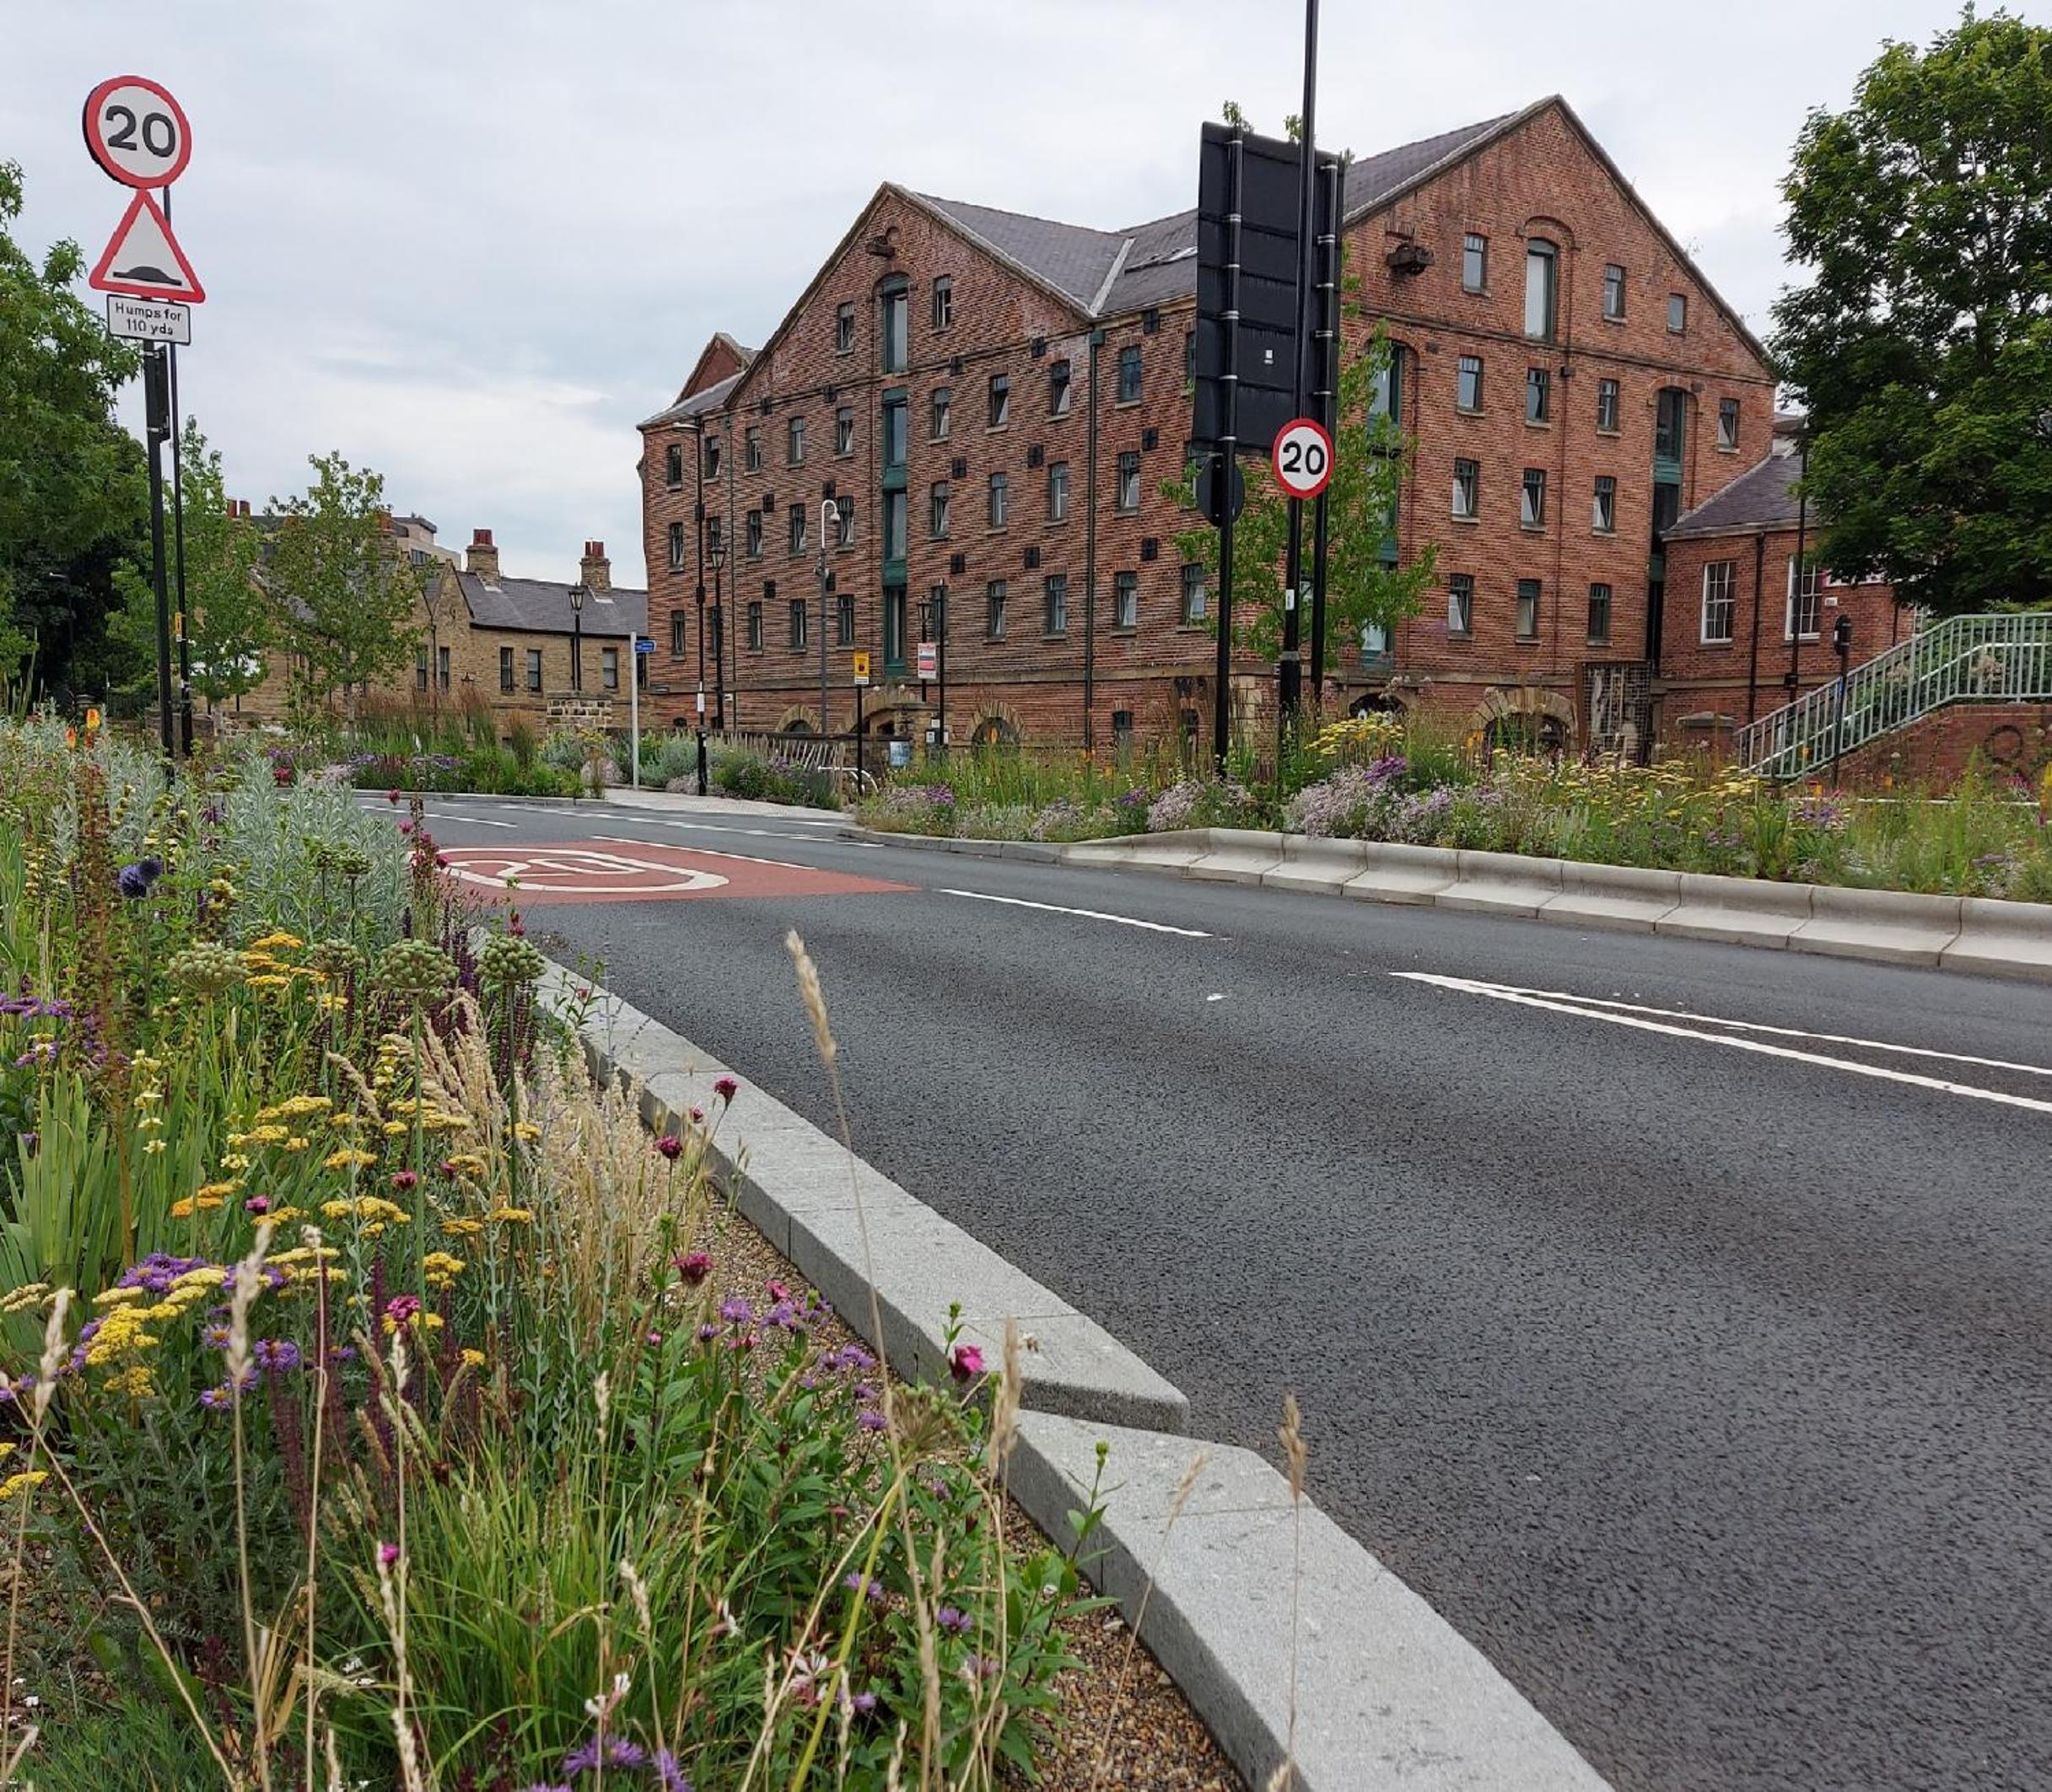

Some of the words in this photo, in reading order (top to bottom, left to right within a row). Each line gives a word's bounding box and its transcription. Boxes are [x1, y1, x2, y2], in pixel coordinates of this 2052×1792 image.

[105, 105, 176, 158] 20
[115, 303, 161, 319] Humps
[164, 309, 181, 321] for
[127, 318, 147, 331] 110
[150, 323, 173, 336] yds
[1283, 440, 1325, 475] 20
[447, 858, 646, 877] 20
